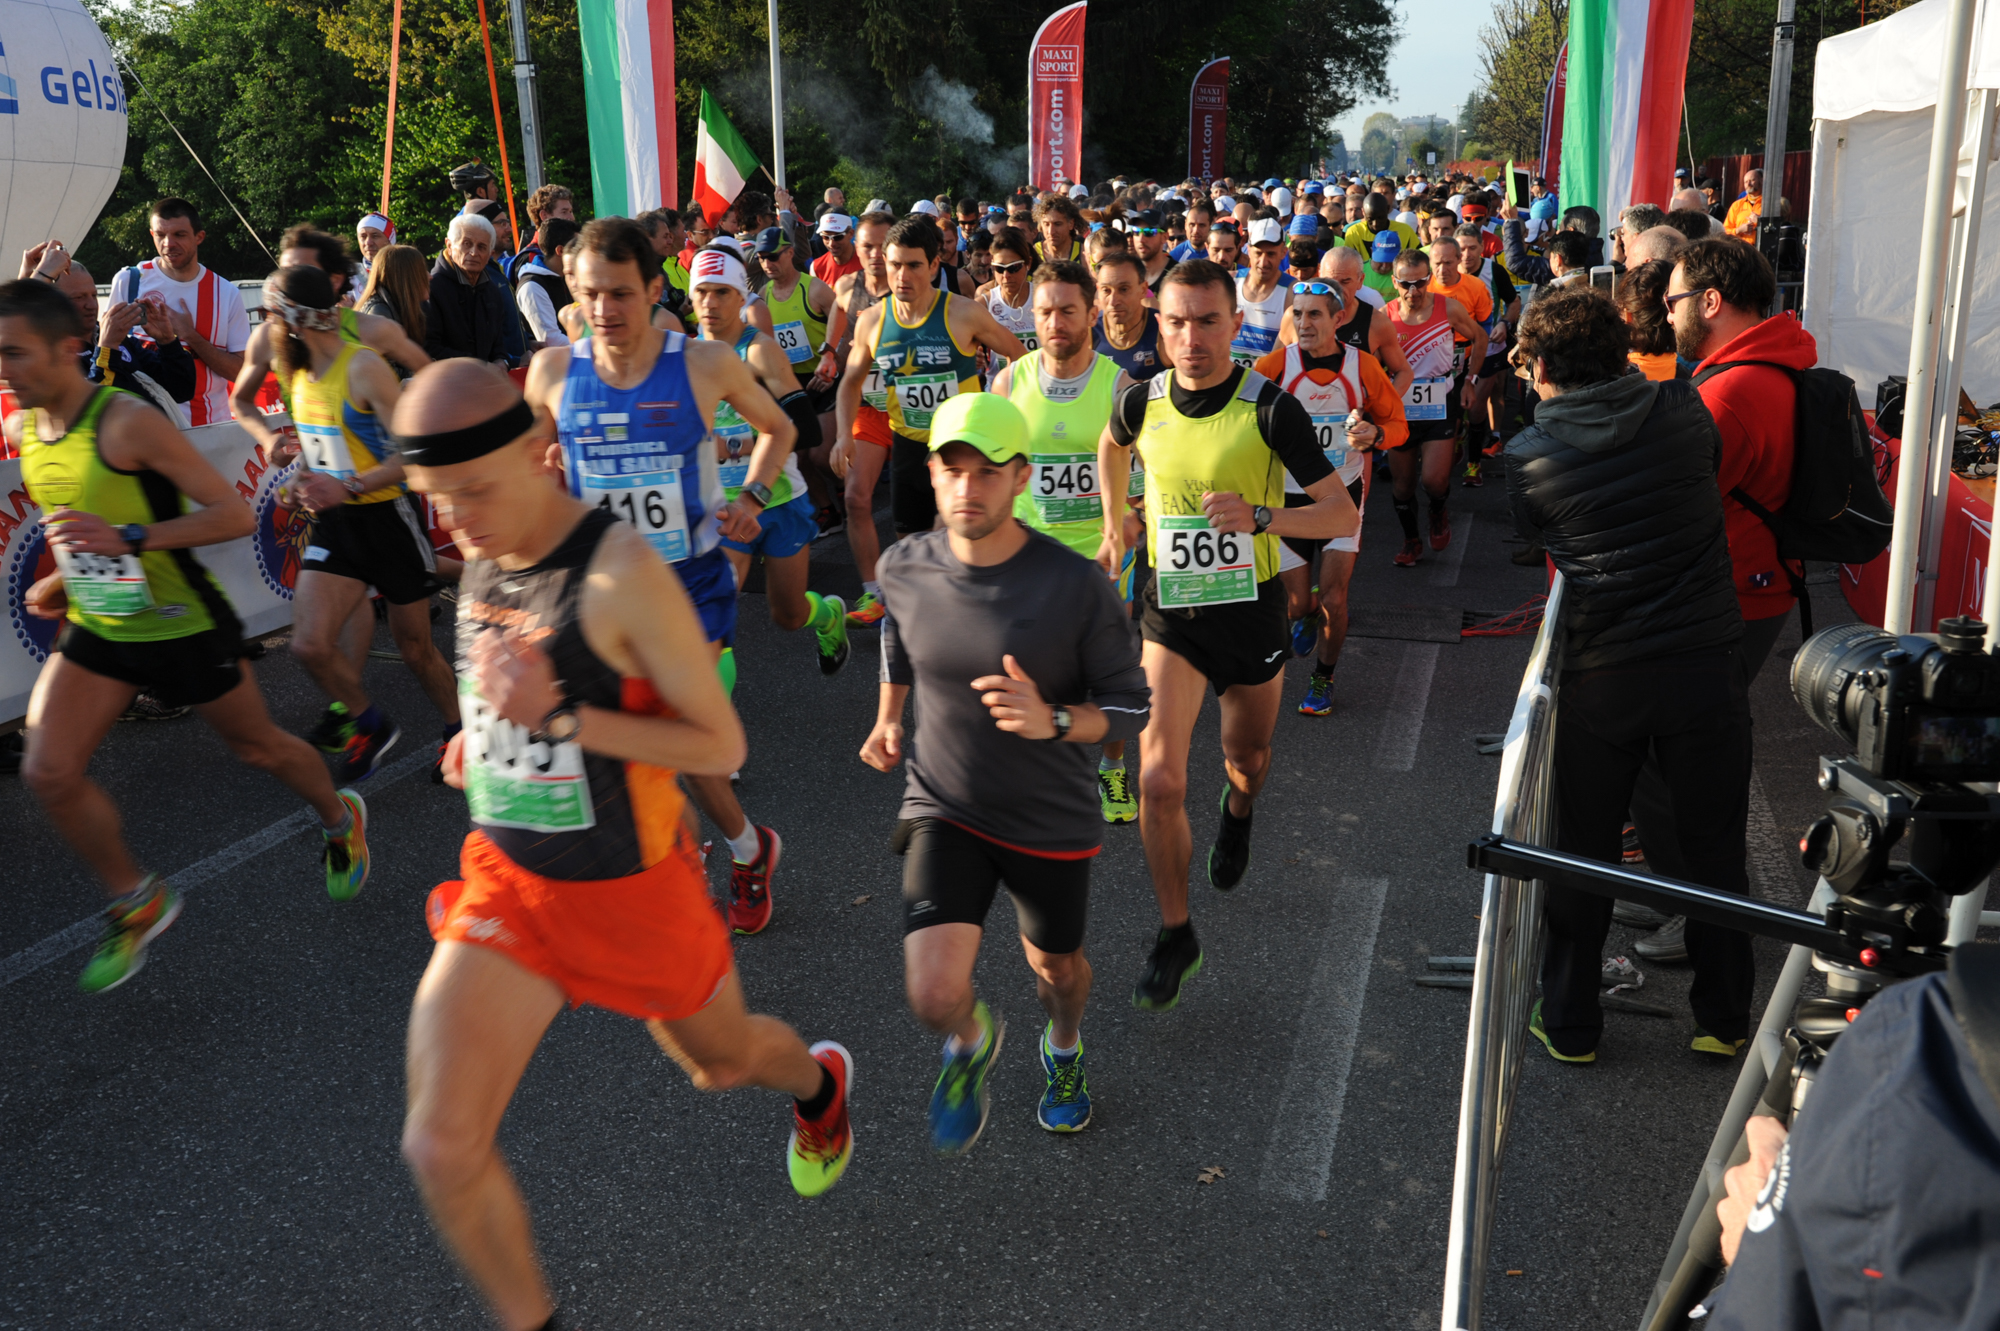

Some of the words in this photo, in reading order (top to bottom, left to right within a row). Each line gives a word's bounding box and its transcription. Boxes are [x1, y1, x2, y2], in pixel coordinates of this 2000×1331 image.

[1043, 49, 1073, 60] MAXI
[1039, 61, 1076, 72] SPORT
[1199, 86, 1221, 96] MAXI
[1197, 95, 1222, 104] SPORT
[777, 329, 797, 349] 83
[916, 345, 952, 353] BERGAMO
[906, 382, 951, 408] 504
[1412, 385, 1432, 404] 51
[1040, 463, 1094, 495] 546
[1184, 479, 1217, 492] VINI
[597, 490, 666, 529] 116
[1171, 531, 1239, 569] 566
